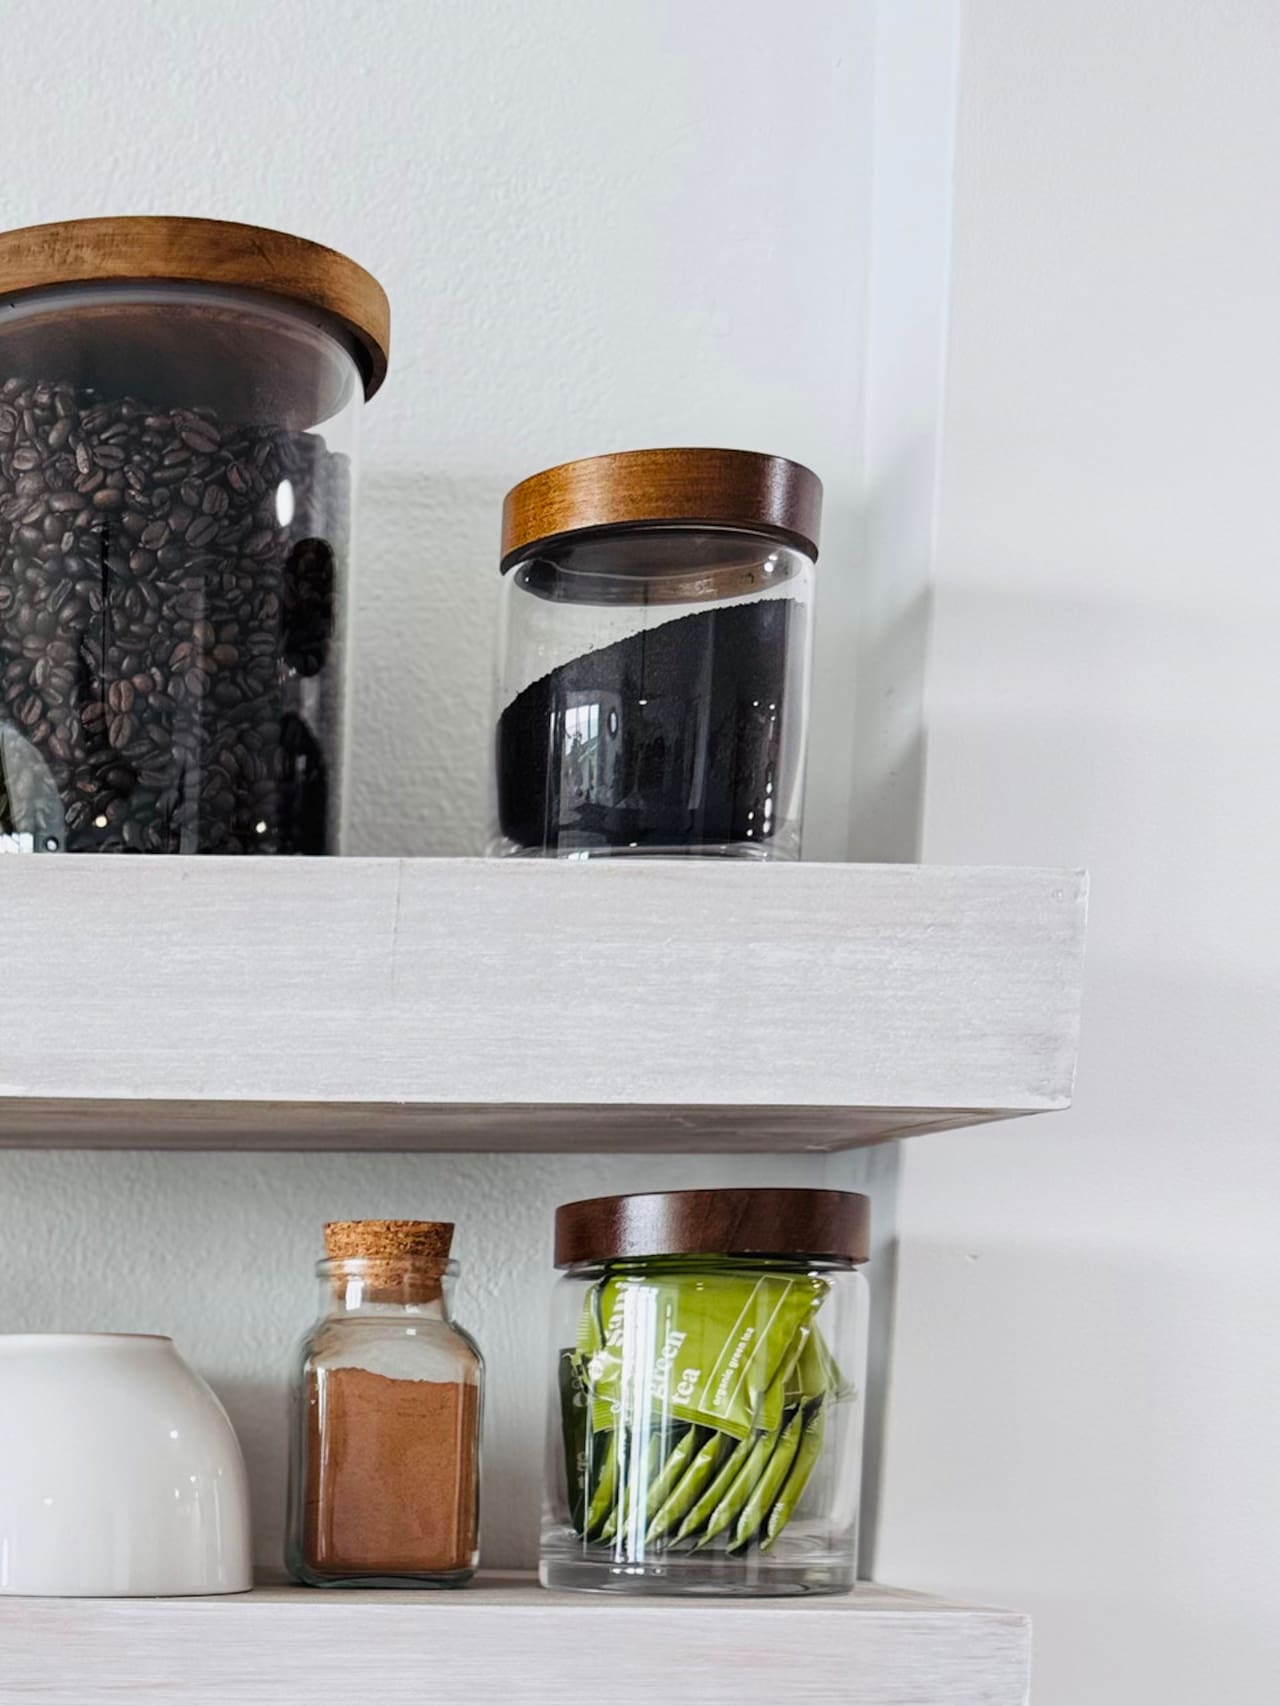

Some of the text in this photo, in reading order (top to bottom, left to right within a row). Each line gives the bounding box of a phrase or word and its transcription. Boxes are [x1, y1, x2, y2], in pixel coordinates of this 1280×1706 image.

[672, 1368, 702, 1404] tea
[712, 1327, 756, 1406] organic green tea
